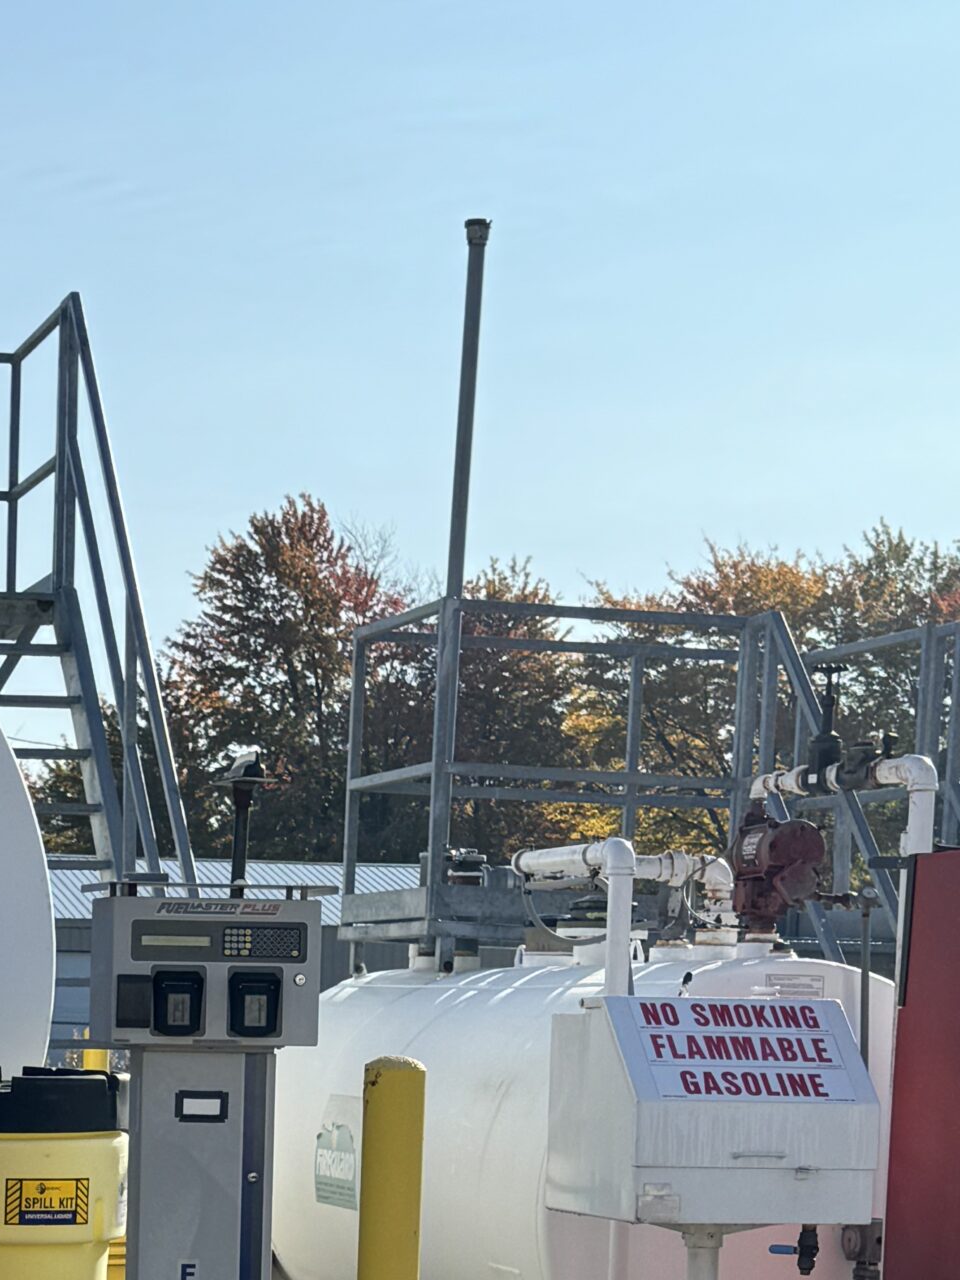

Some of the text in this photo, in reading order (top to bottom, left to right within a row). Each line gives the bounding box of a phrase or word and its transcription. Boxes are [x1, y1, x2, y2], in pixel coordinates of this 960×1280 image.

[156, 902, 281, 914] FUELMASTER PLUS
[640, 1002, 821, 1028] NO SMOKING
[649, 1034, 833, 1063] FLAMMABLE
[679, 1070, 829, 1097] GASOLINE
[24, 1197, 75, 1209] SPILL KIT
